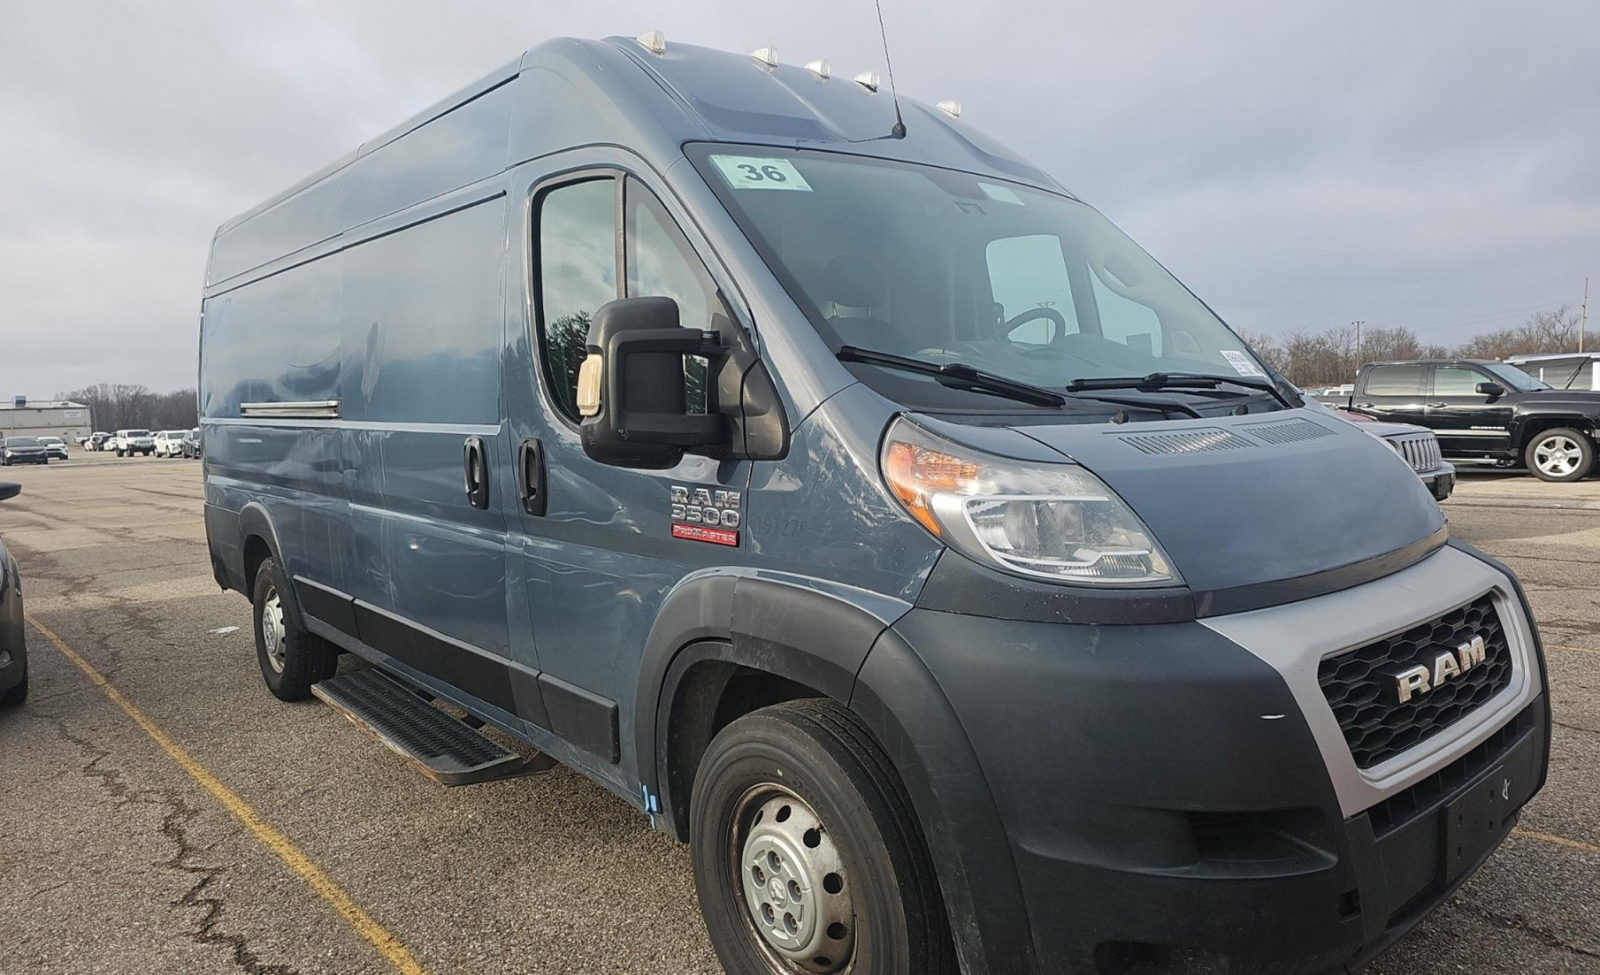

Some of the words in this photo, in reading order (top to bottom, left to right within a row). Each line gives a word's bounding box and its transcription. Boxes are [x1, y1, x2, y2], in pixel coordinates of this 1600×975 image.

[737, 164, 787, 182] 36
[671, 486, 741, 509] RAM
[671, 503, 740, 528] 3500
[1396, 634, 1486, 704] RAM
